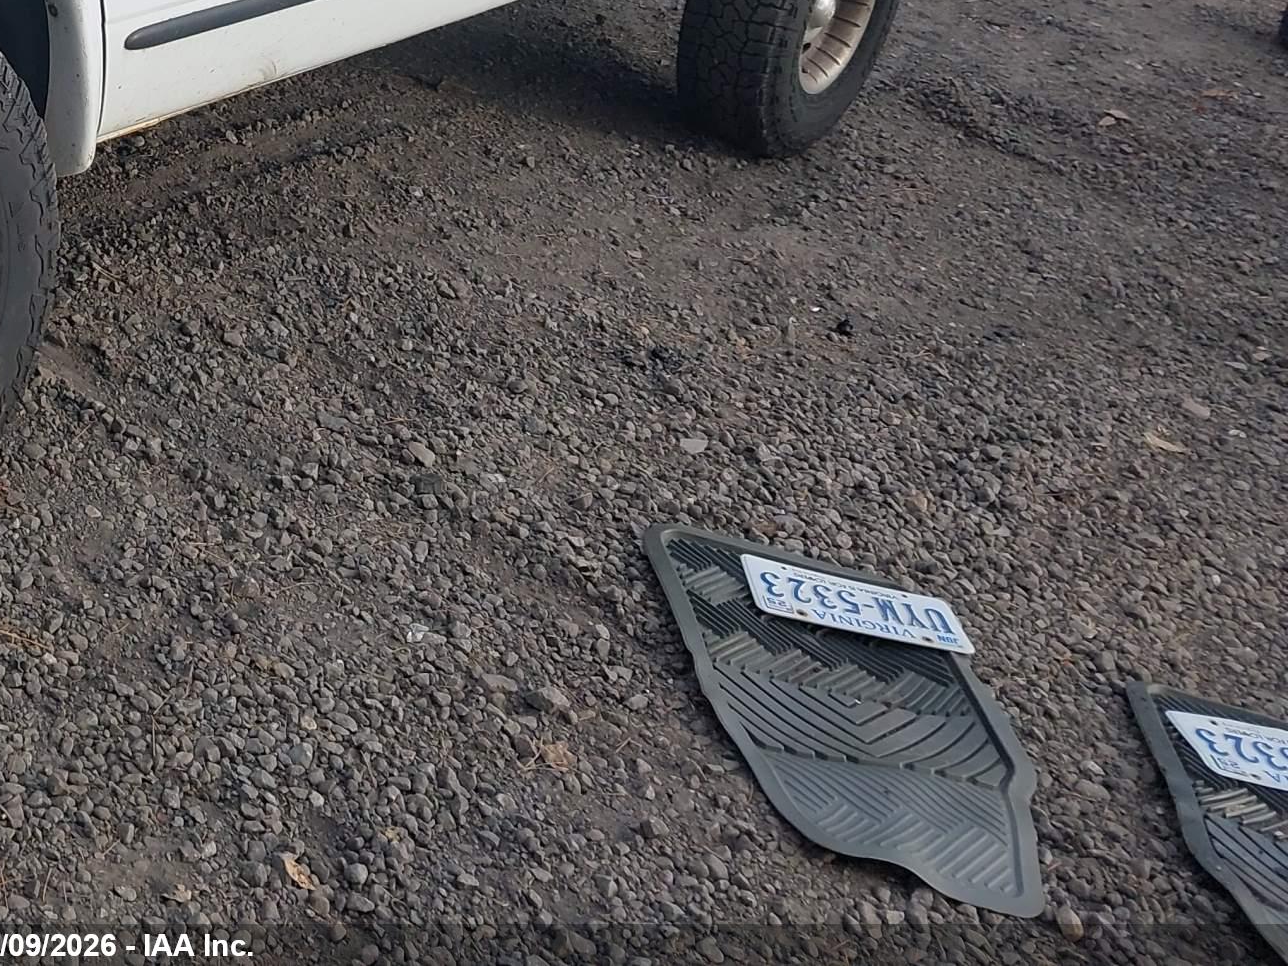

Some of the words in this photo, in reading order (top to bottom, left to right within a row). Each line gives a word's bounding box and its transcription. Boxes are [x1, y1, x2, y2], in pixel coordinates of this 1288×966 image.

[759, 570, 955, 636] UYM-5323
[812, 608, 917, 640] VIRGINIA
[936, 634, 960, 645] JUN
